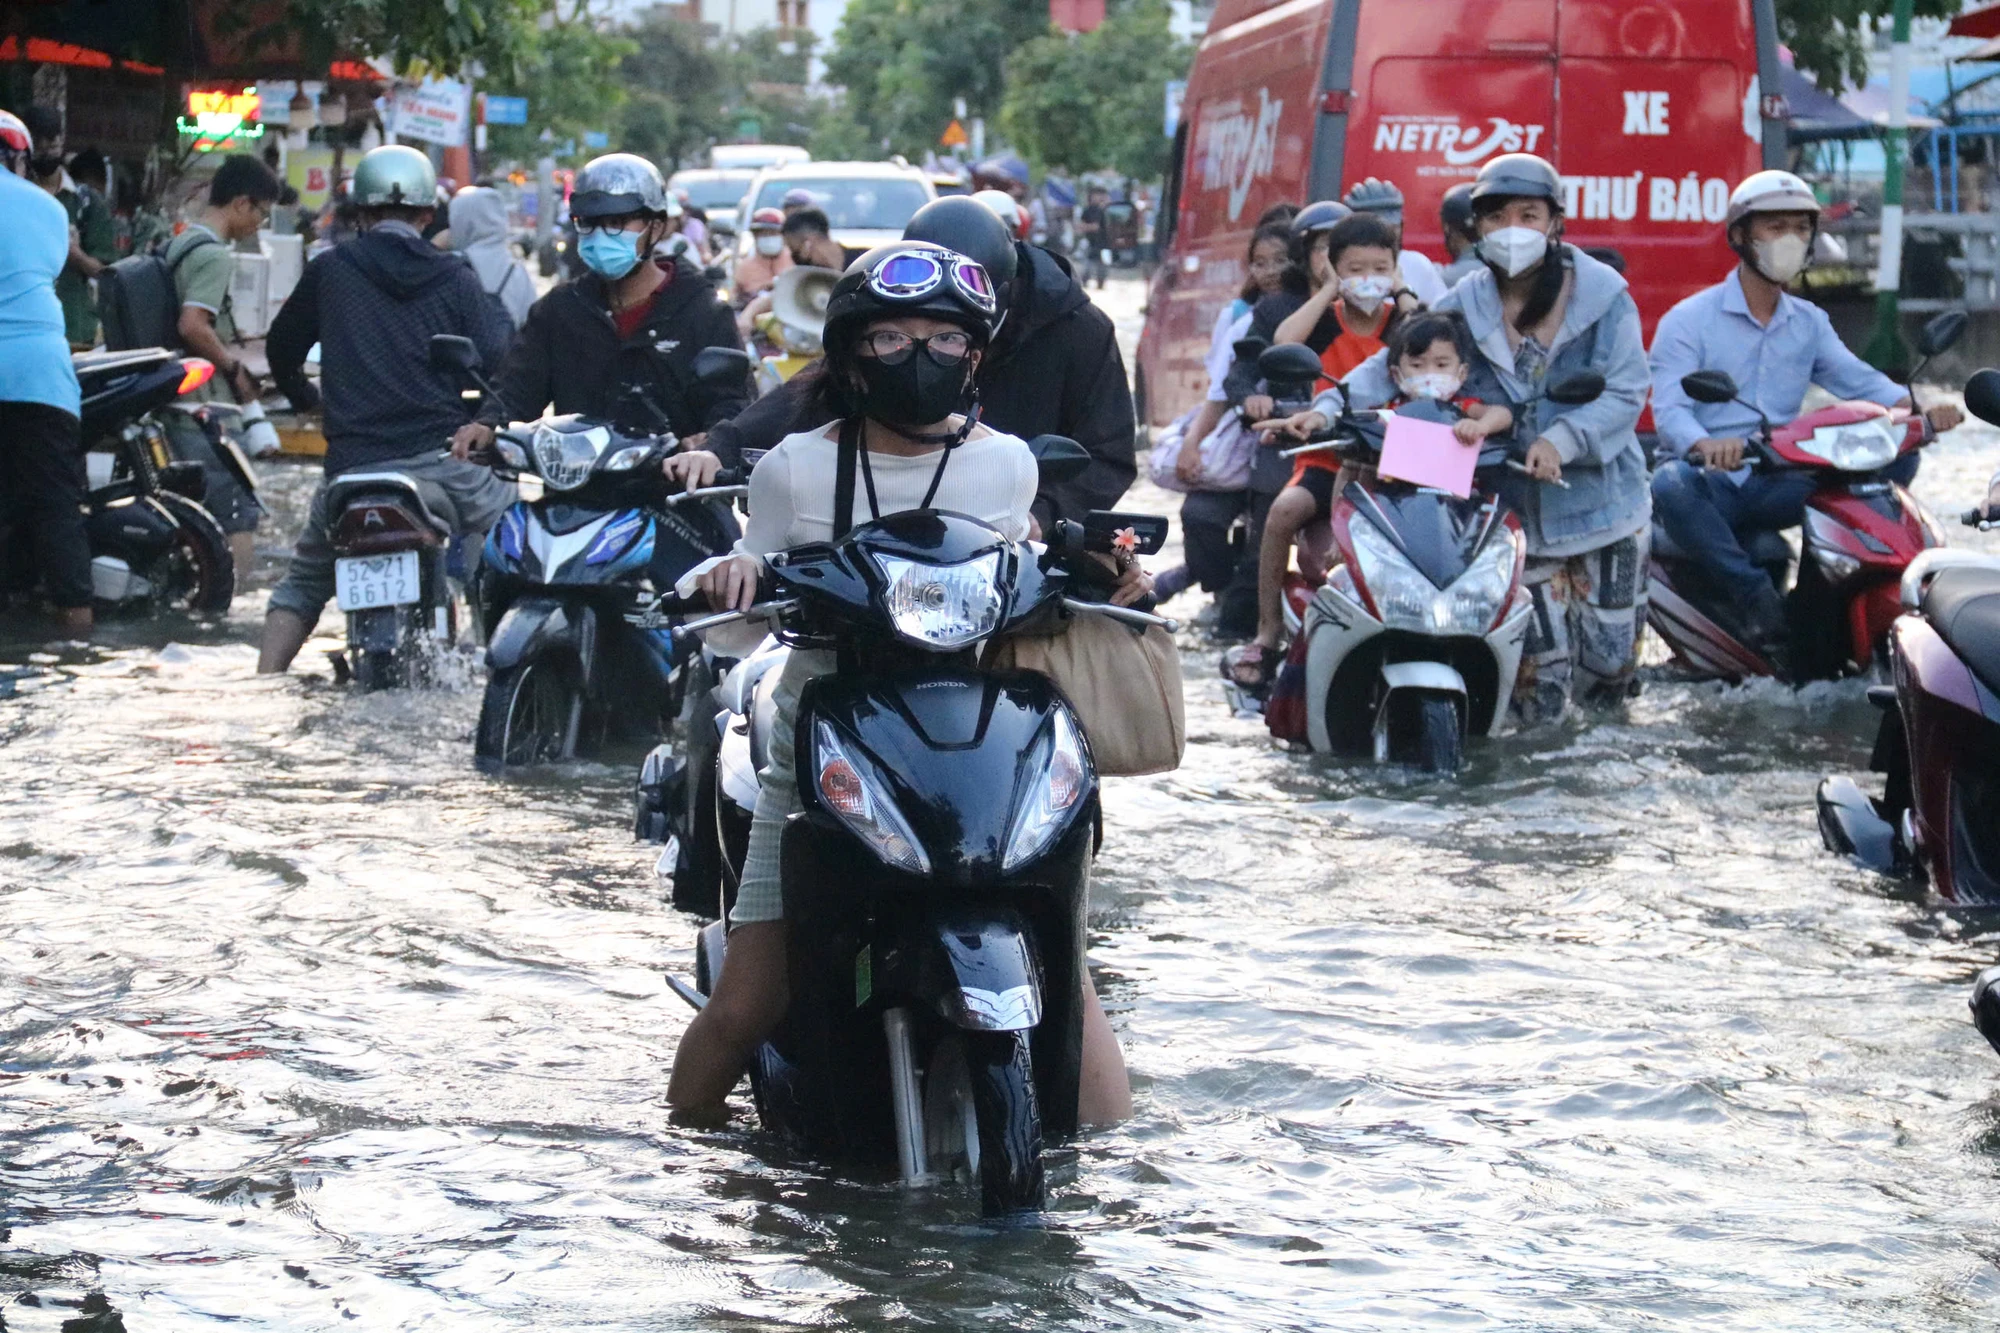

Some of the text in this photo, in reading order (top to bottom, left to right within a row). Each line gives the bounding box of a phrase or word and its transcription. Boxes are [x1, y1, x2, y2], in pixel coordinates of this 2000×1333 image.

[1622, 90, 1670, 135] XE
[1560, 170, 1729, 223] THƯ BÁO
[348, 579, 407, 605] 6612
[916, 681, 969, 690] HONDA
